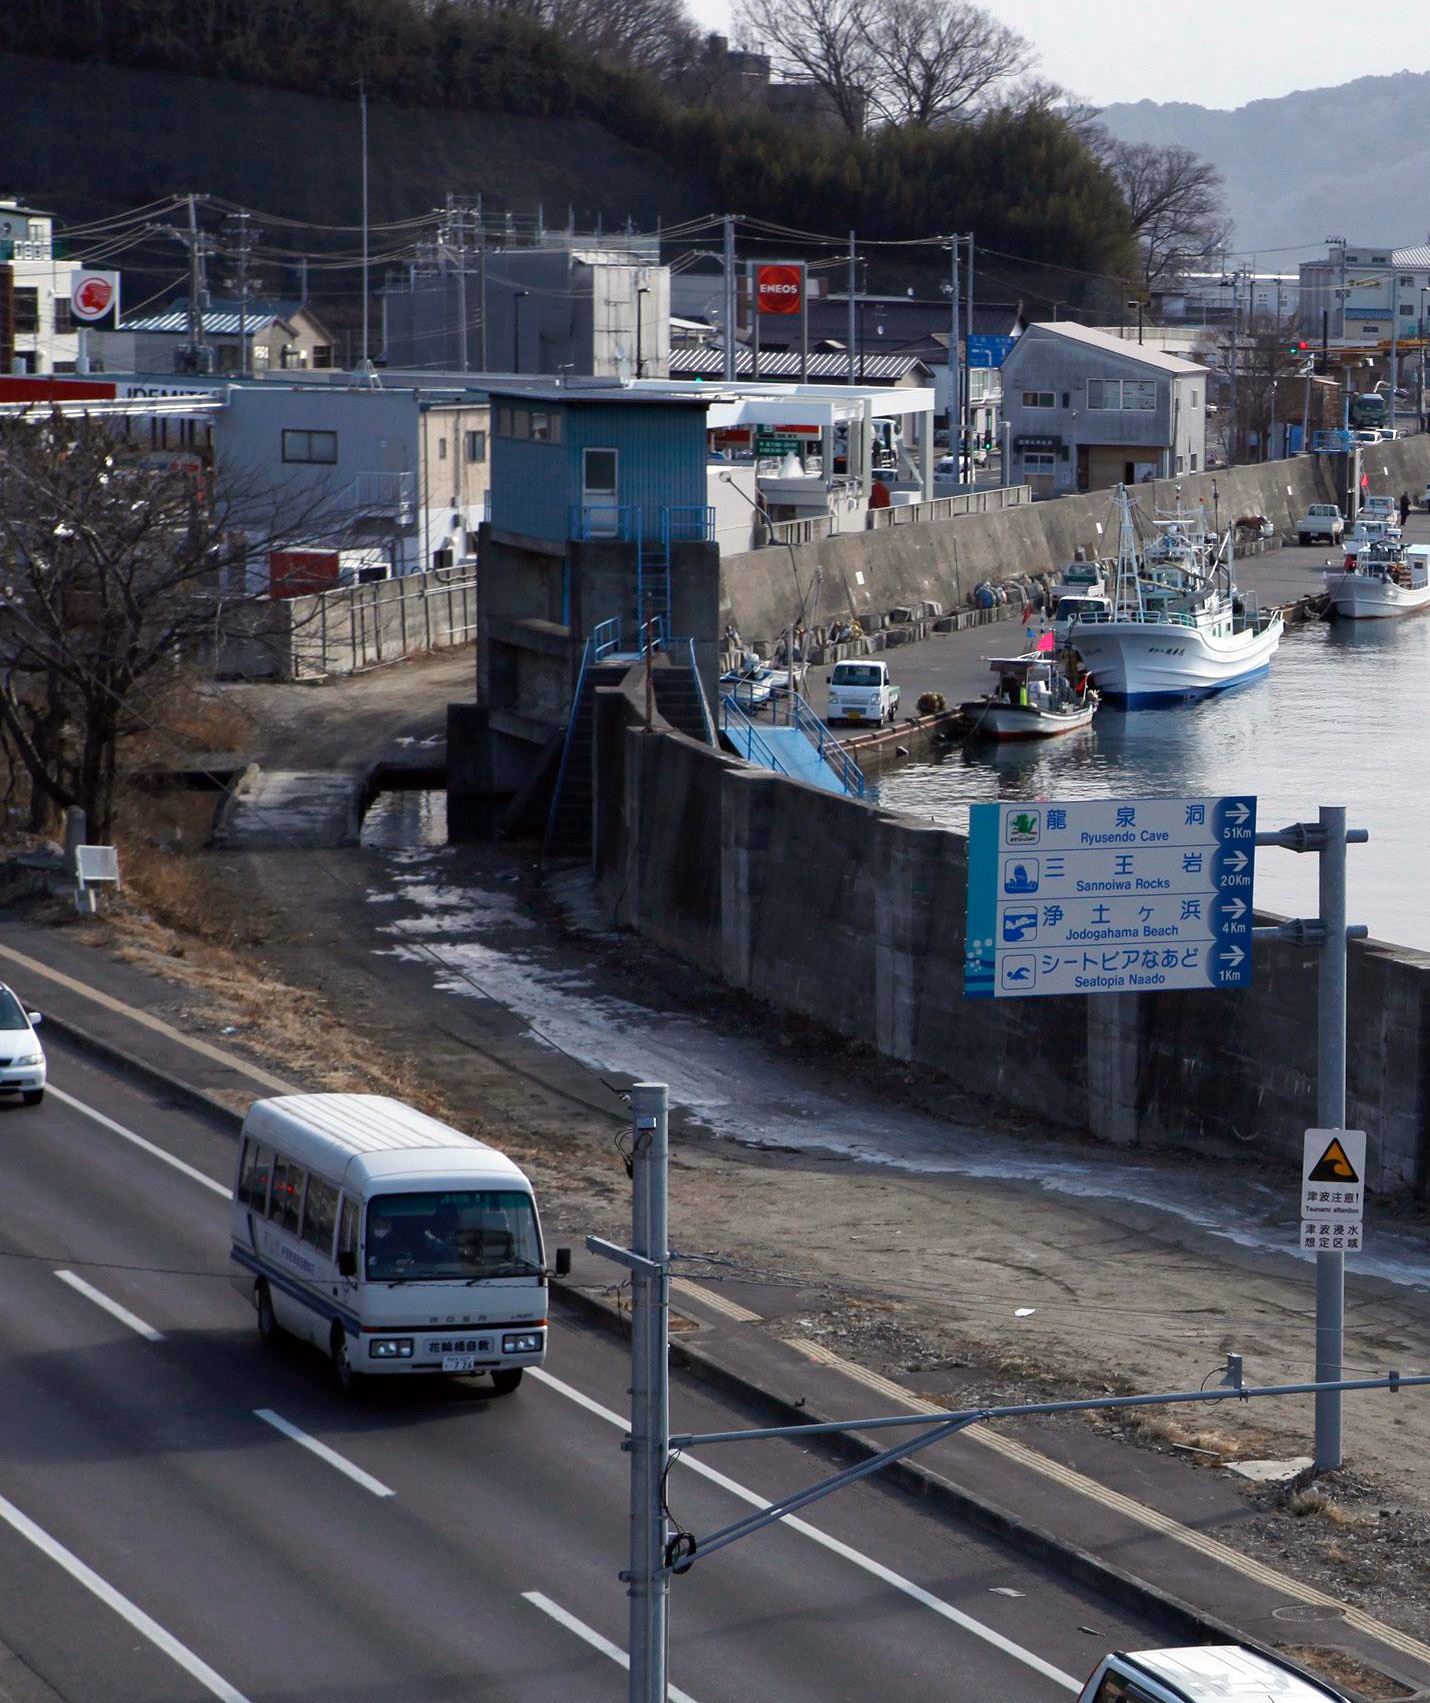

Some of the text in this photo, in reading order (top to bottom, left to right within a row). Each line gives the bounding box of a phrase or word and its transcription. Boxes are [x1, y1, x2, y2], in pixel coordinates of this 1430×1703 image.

[760, 284, 798, 294] ENEOS
[1046, 804, 1205, 830] 龍泉洞
[1081, 830, 1169, 845] Ryusendo Cave
[1223, 827, 1252, 839] 51Km
[1045, 852, 1202, 877] 三王岩
[1076, 877, 1170, 892] Sannoiwa Rocks
[1220, 874, 1251, 887] 20Km
[1066, 925, 1179, 941] Jodogahama Beach
[1042, 947, 1200, 974] シートピアなあど
[1075, 973, 1166, 988] Seatopia Naado
[1219, 970, 1241, 981] 1Km
[1305, 1224, 1359, 1236] 津波浸水
[1305, 1237, 1359, 1249] 想定区域
